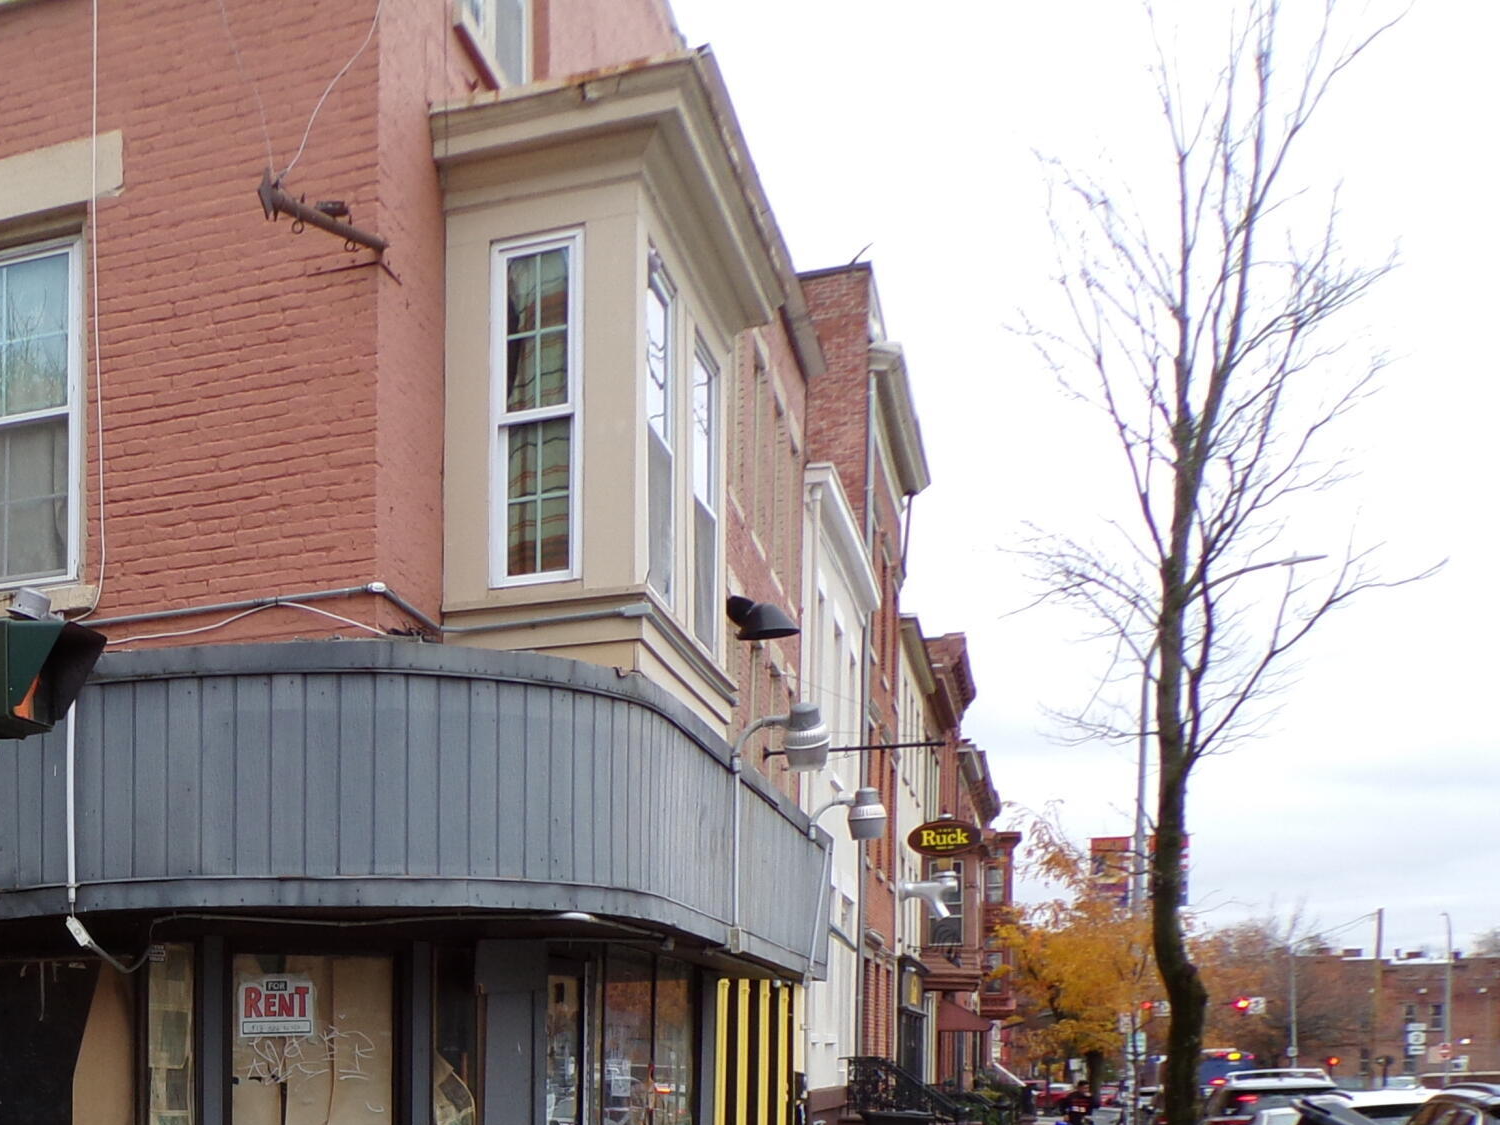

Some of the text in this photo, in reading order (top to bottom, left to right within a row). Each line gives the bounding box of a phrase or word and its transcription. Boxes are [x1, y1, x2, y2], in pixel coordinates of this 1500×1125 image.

[921, 828, 970, 847] Ruck
[267, 982, 286, 991] FOR
[244, 986, 310, 1019] RENT
